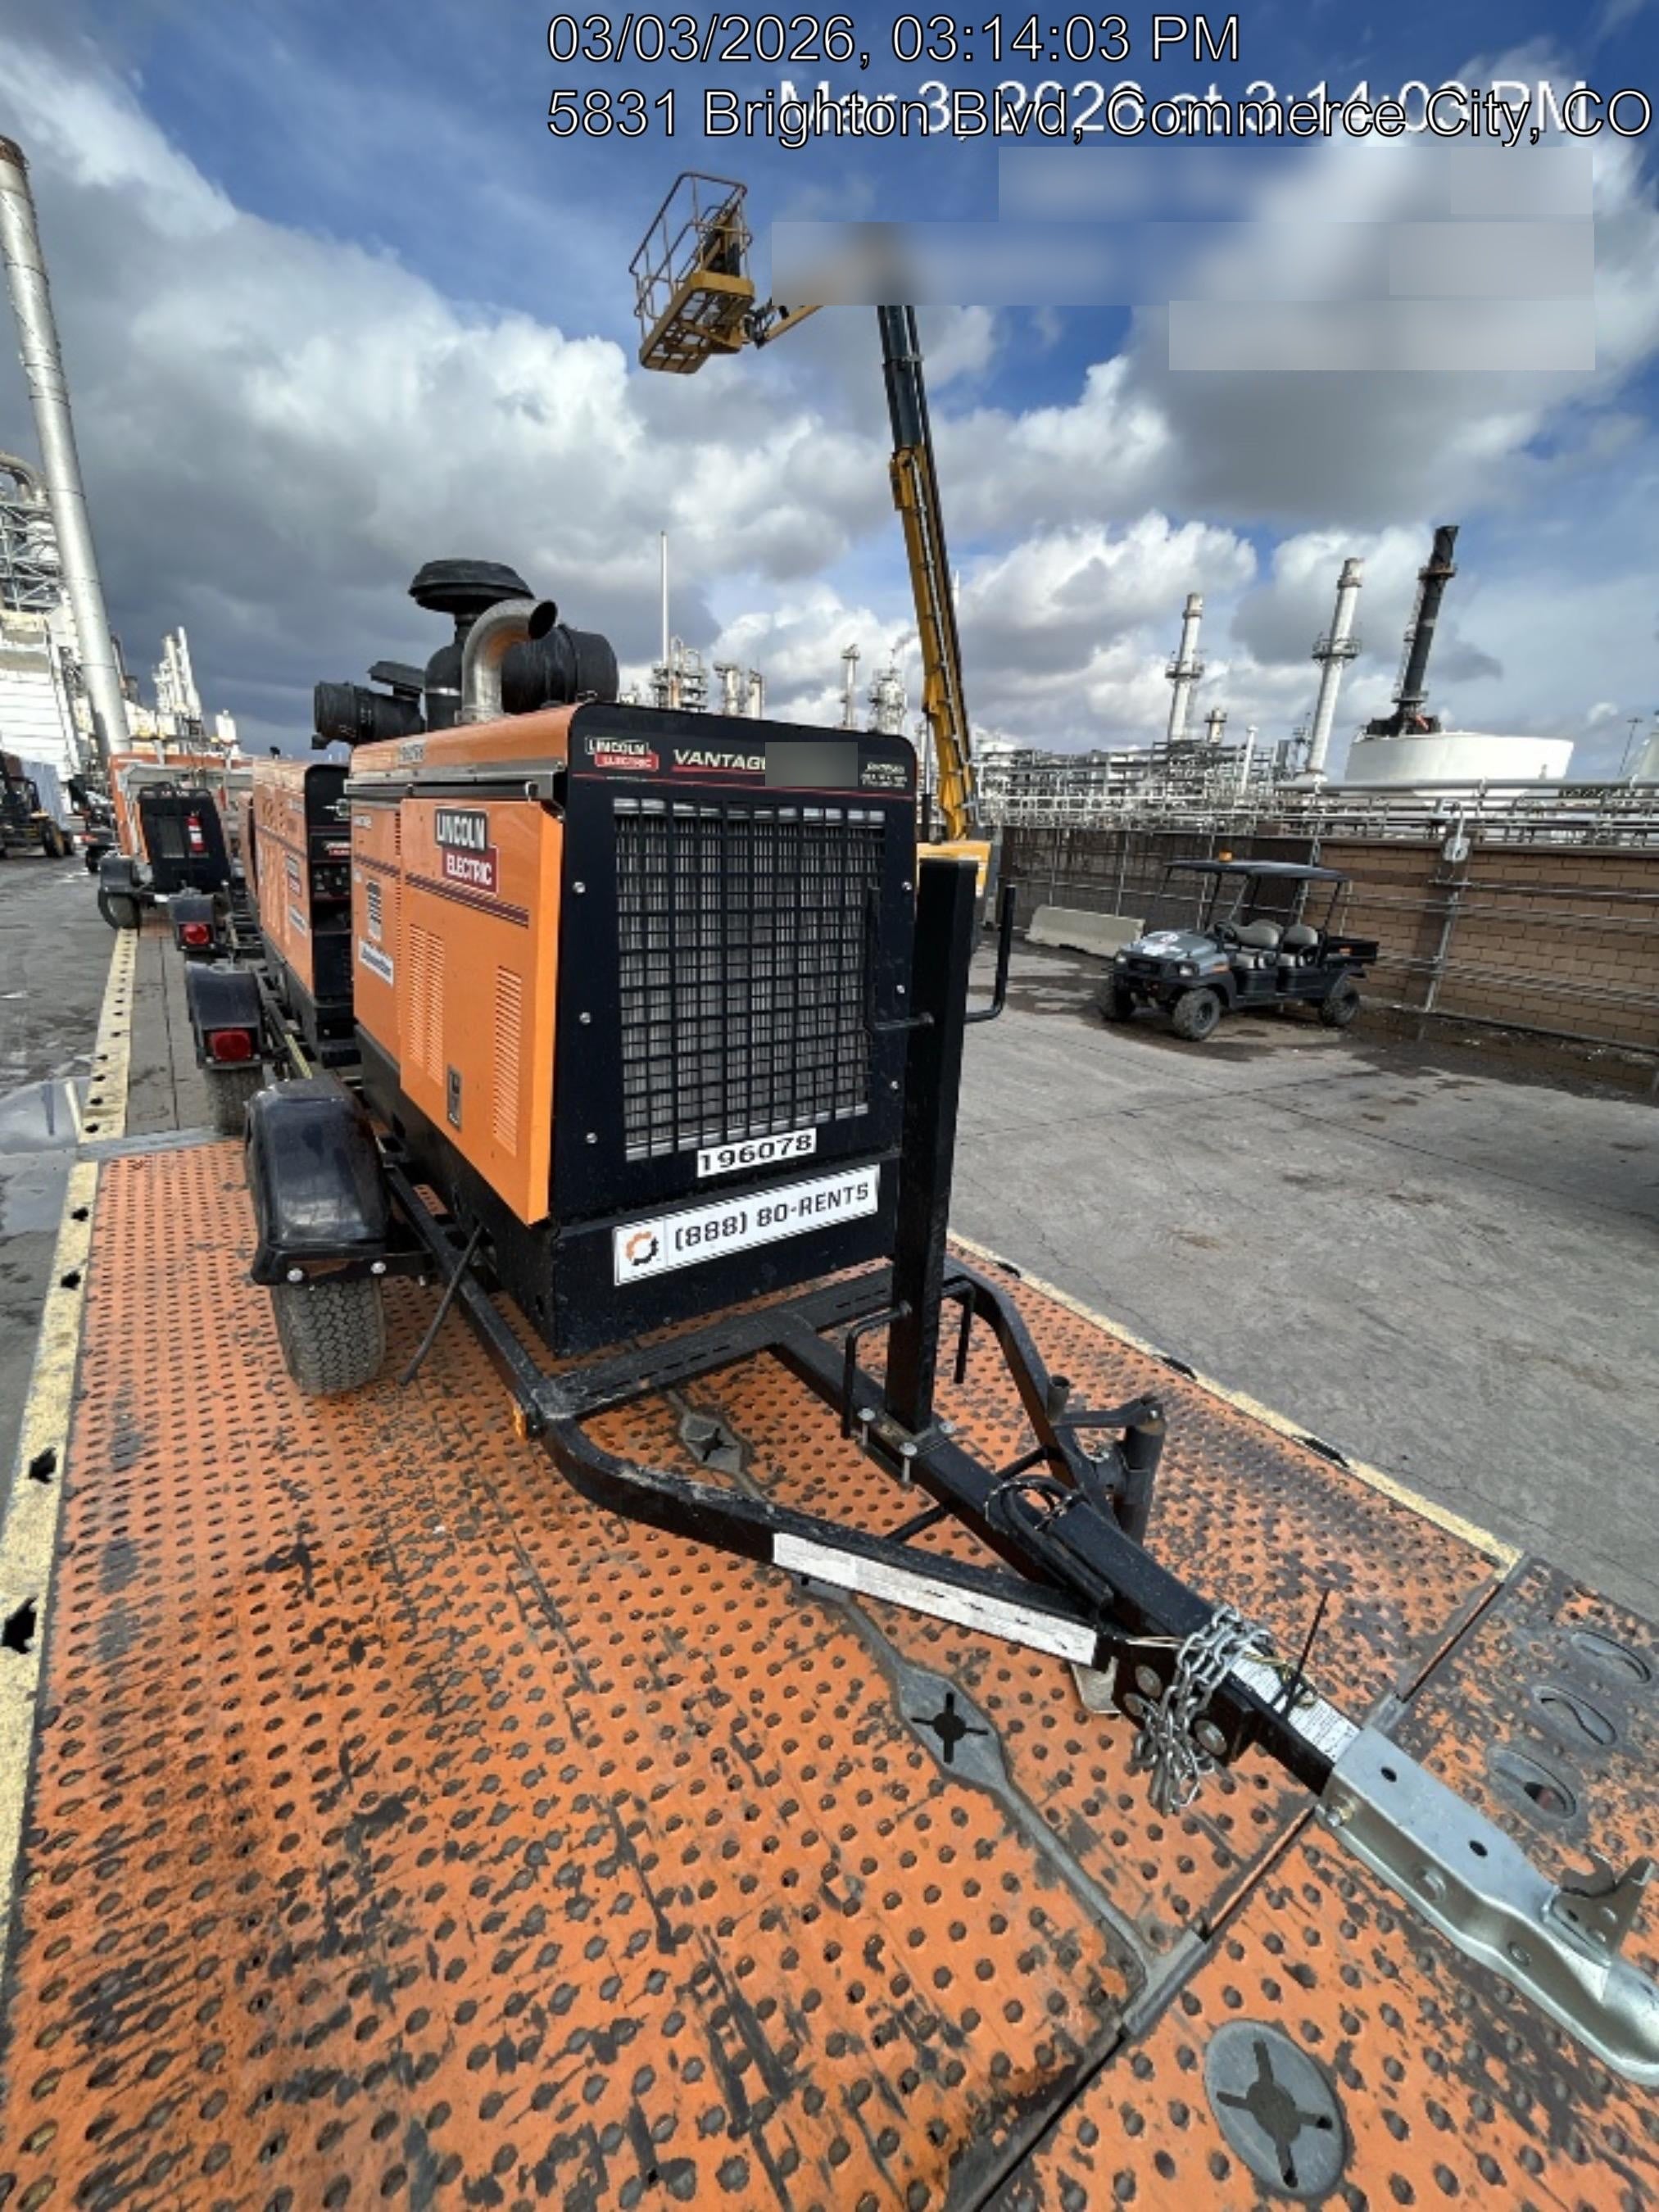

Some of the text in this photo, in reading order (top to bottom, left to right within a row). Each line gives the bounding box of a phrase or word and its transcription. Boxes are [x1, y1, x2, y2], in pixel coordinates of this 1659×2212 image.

[588, 738, 646, 755] LINCOLN
[436, 812, 486, 851] LINCOLN
[446, 852, 493, 886] ELECTRIC
[700, 1134, 813, 1172] 196078
[675, 1181, 870, 1251] (888) 80-RENTS
